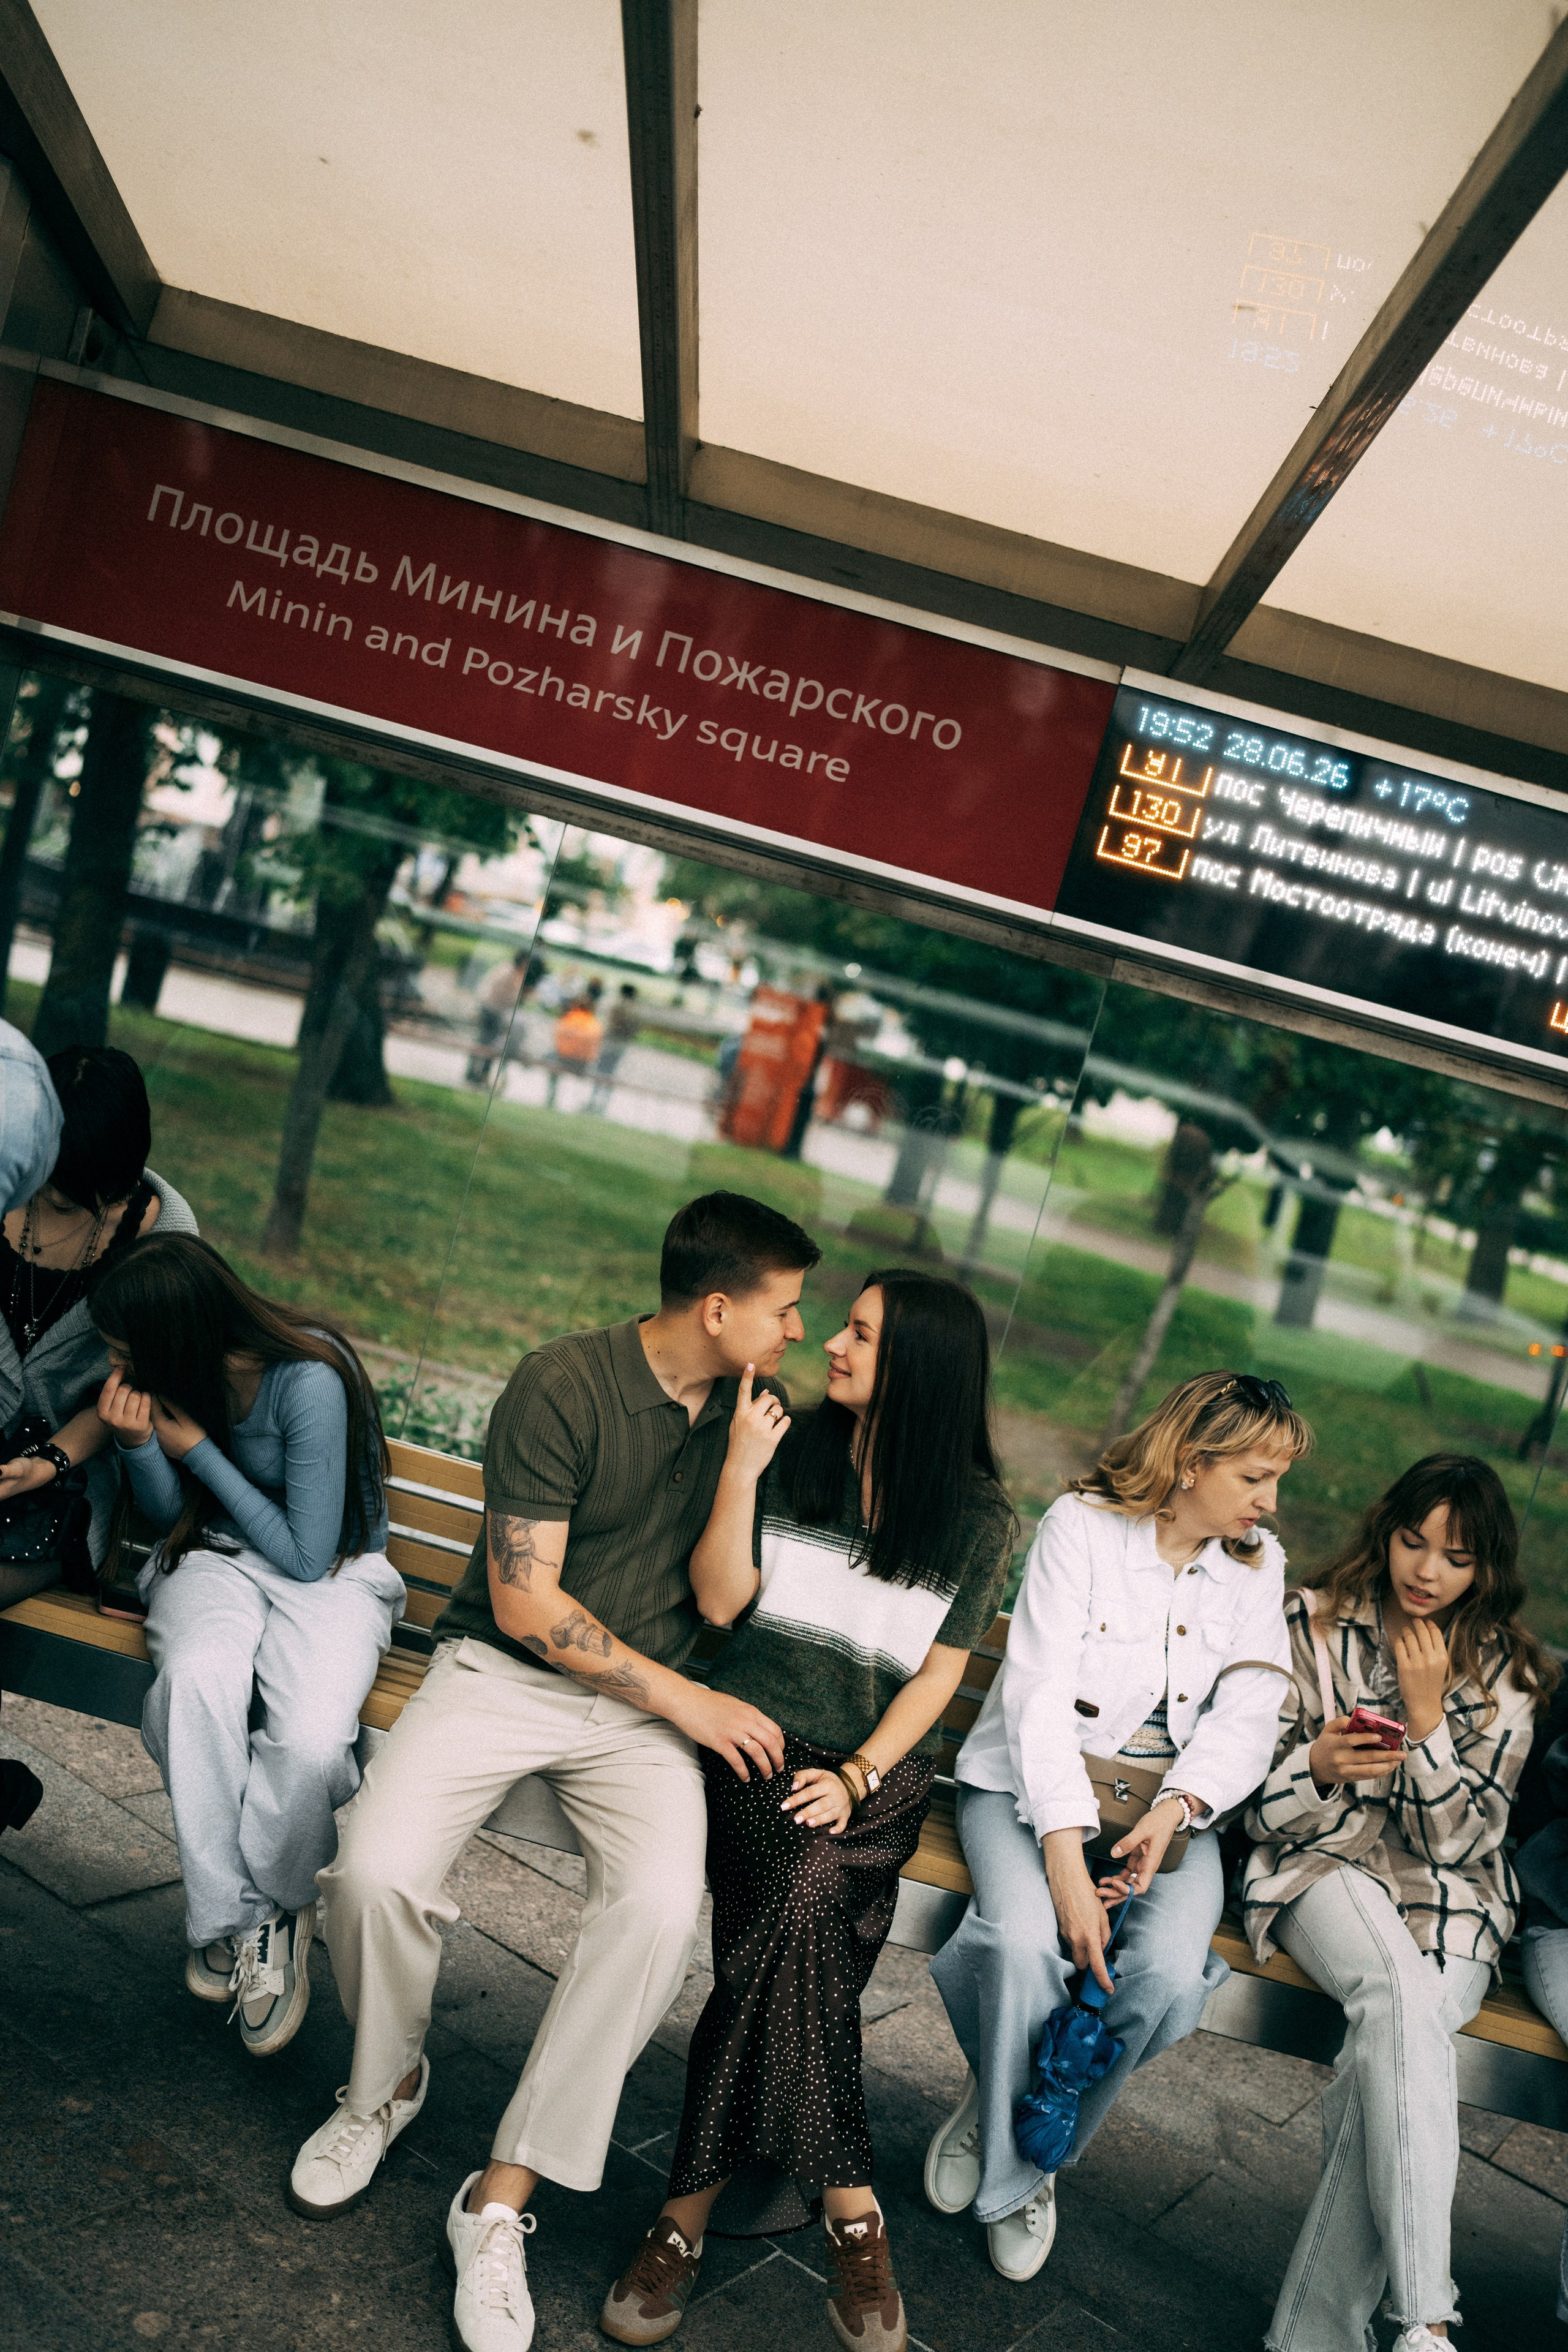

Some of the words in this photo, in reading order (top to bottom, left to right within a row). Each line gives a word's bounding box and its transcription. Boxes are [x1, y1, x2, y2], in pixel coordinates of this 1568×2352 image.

[147, 483, 380, 585] Площадь
[390, 555, 598, 647] Минина
[610, 625, 644, 660] и
[655, 630, 963, 750] Пожарского
[226, 580, 354, 641] Minin
[364, 625, 452, 668] and
[462, 647, 688, 741] Pozharsky
[696, 719, 851, 783] square
[1139, 707, 1214, 750] 19:52
[1223, 733, 1349, 788] 28.06.26
[1215, 773, 1265, 807] пос
[1121, 833, 1162, 863] 97
[1191, 858, 1241, 889] пос
[1250, 868, 1436, 945] Мостоотряда
[1446, 925, 1550, 979] (конеч)
[1132, 790, 1182, 825] 130
[1202, 818, 1240, 844] ул
[1250, 824, 1398, 889] Литвинова
[1428, 880, 1453, 905] ul
